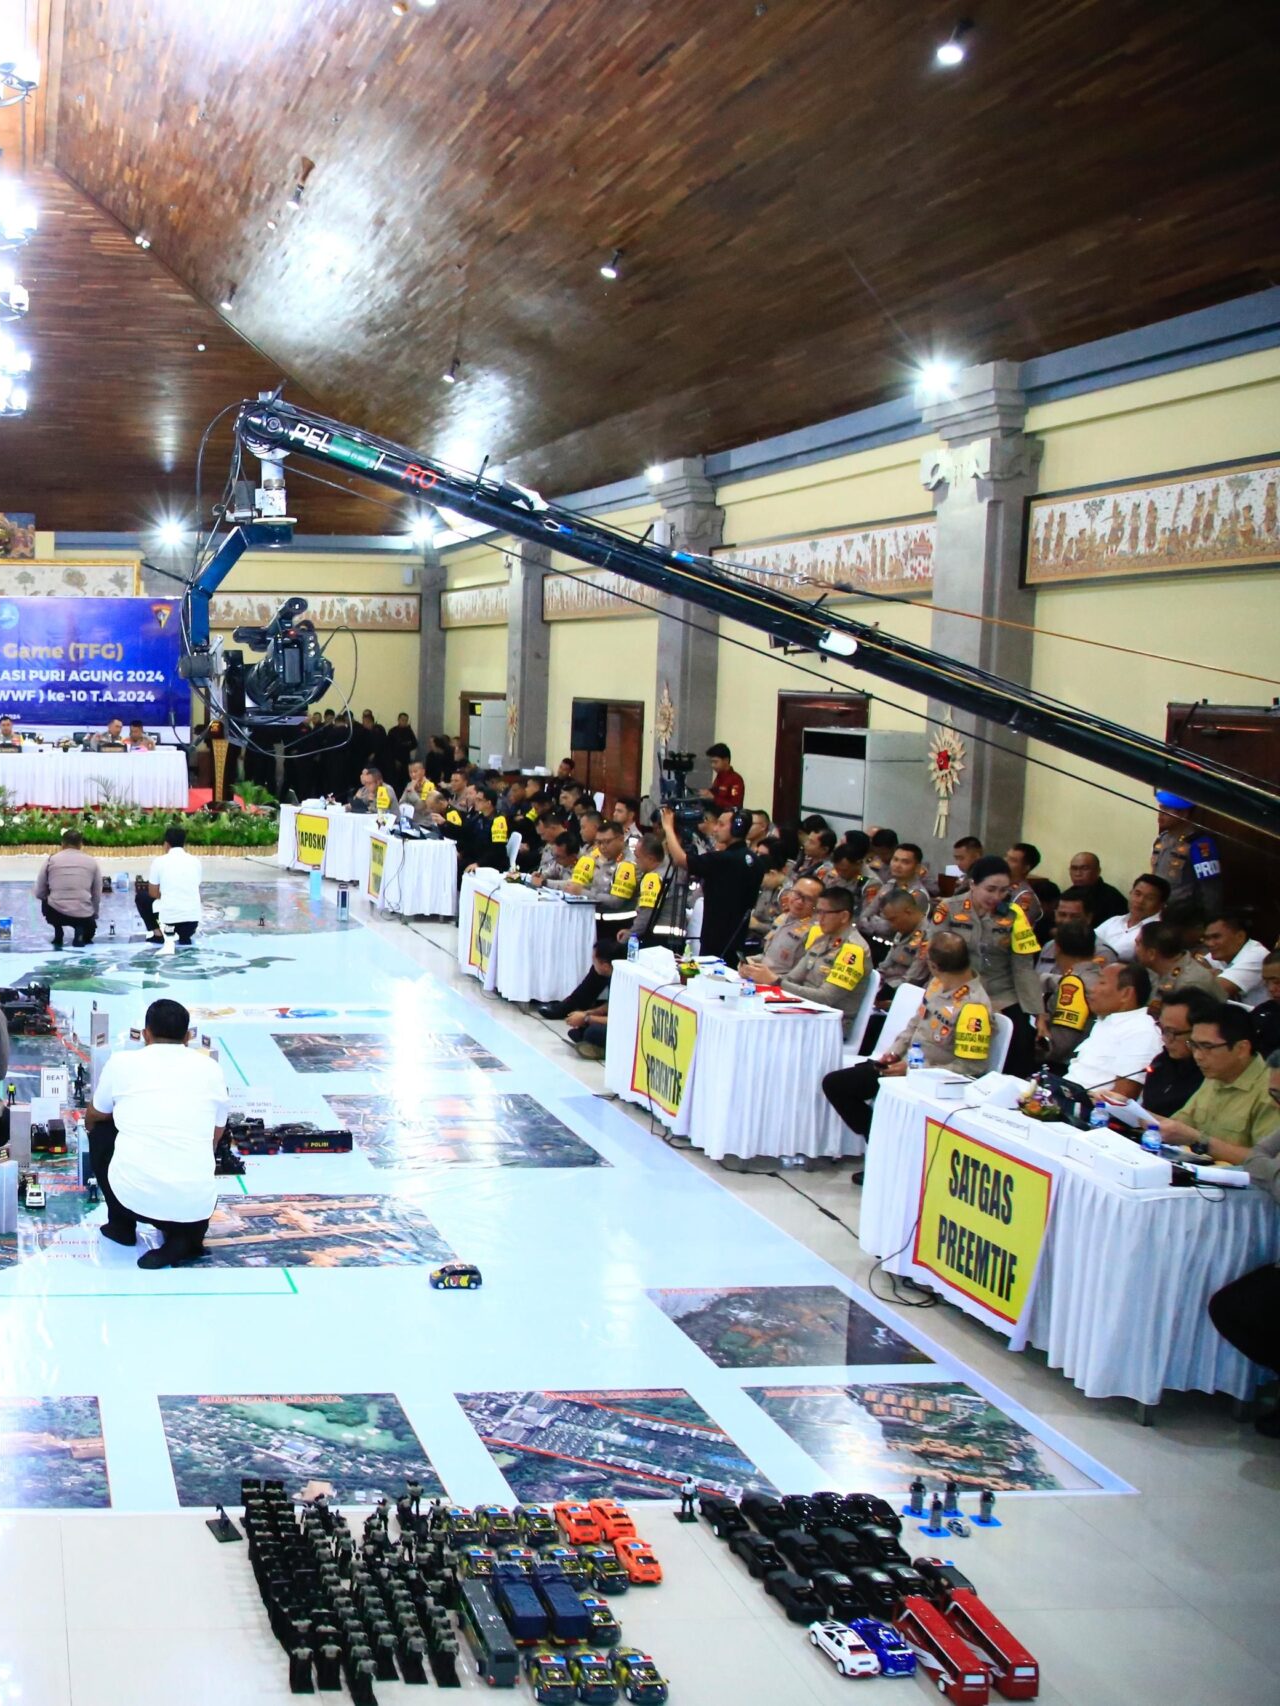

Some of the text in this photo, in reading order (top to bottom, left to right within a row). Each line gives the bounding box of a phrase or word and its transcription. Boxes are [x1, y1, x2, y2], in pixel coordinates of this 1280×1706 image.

[3, 642, 65, 660] Game
[69, 642, 124, 662] (TFG)
[29, 670, 66, 682] PURI
[68, 670, 124, 682] AGUNG
[126, 670, 165, 683] 2024
[47, 690, 87, 702] ke-10
[90, 690, 155, 703] T.A.2024
[651, 1004, 679, 1051] SATGAS
[949, 1149, 1014, 1225] SATGAS
[936, 1214, 1018, 1301] PREEMTIF
